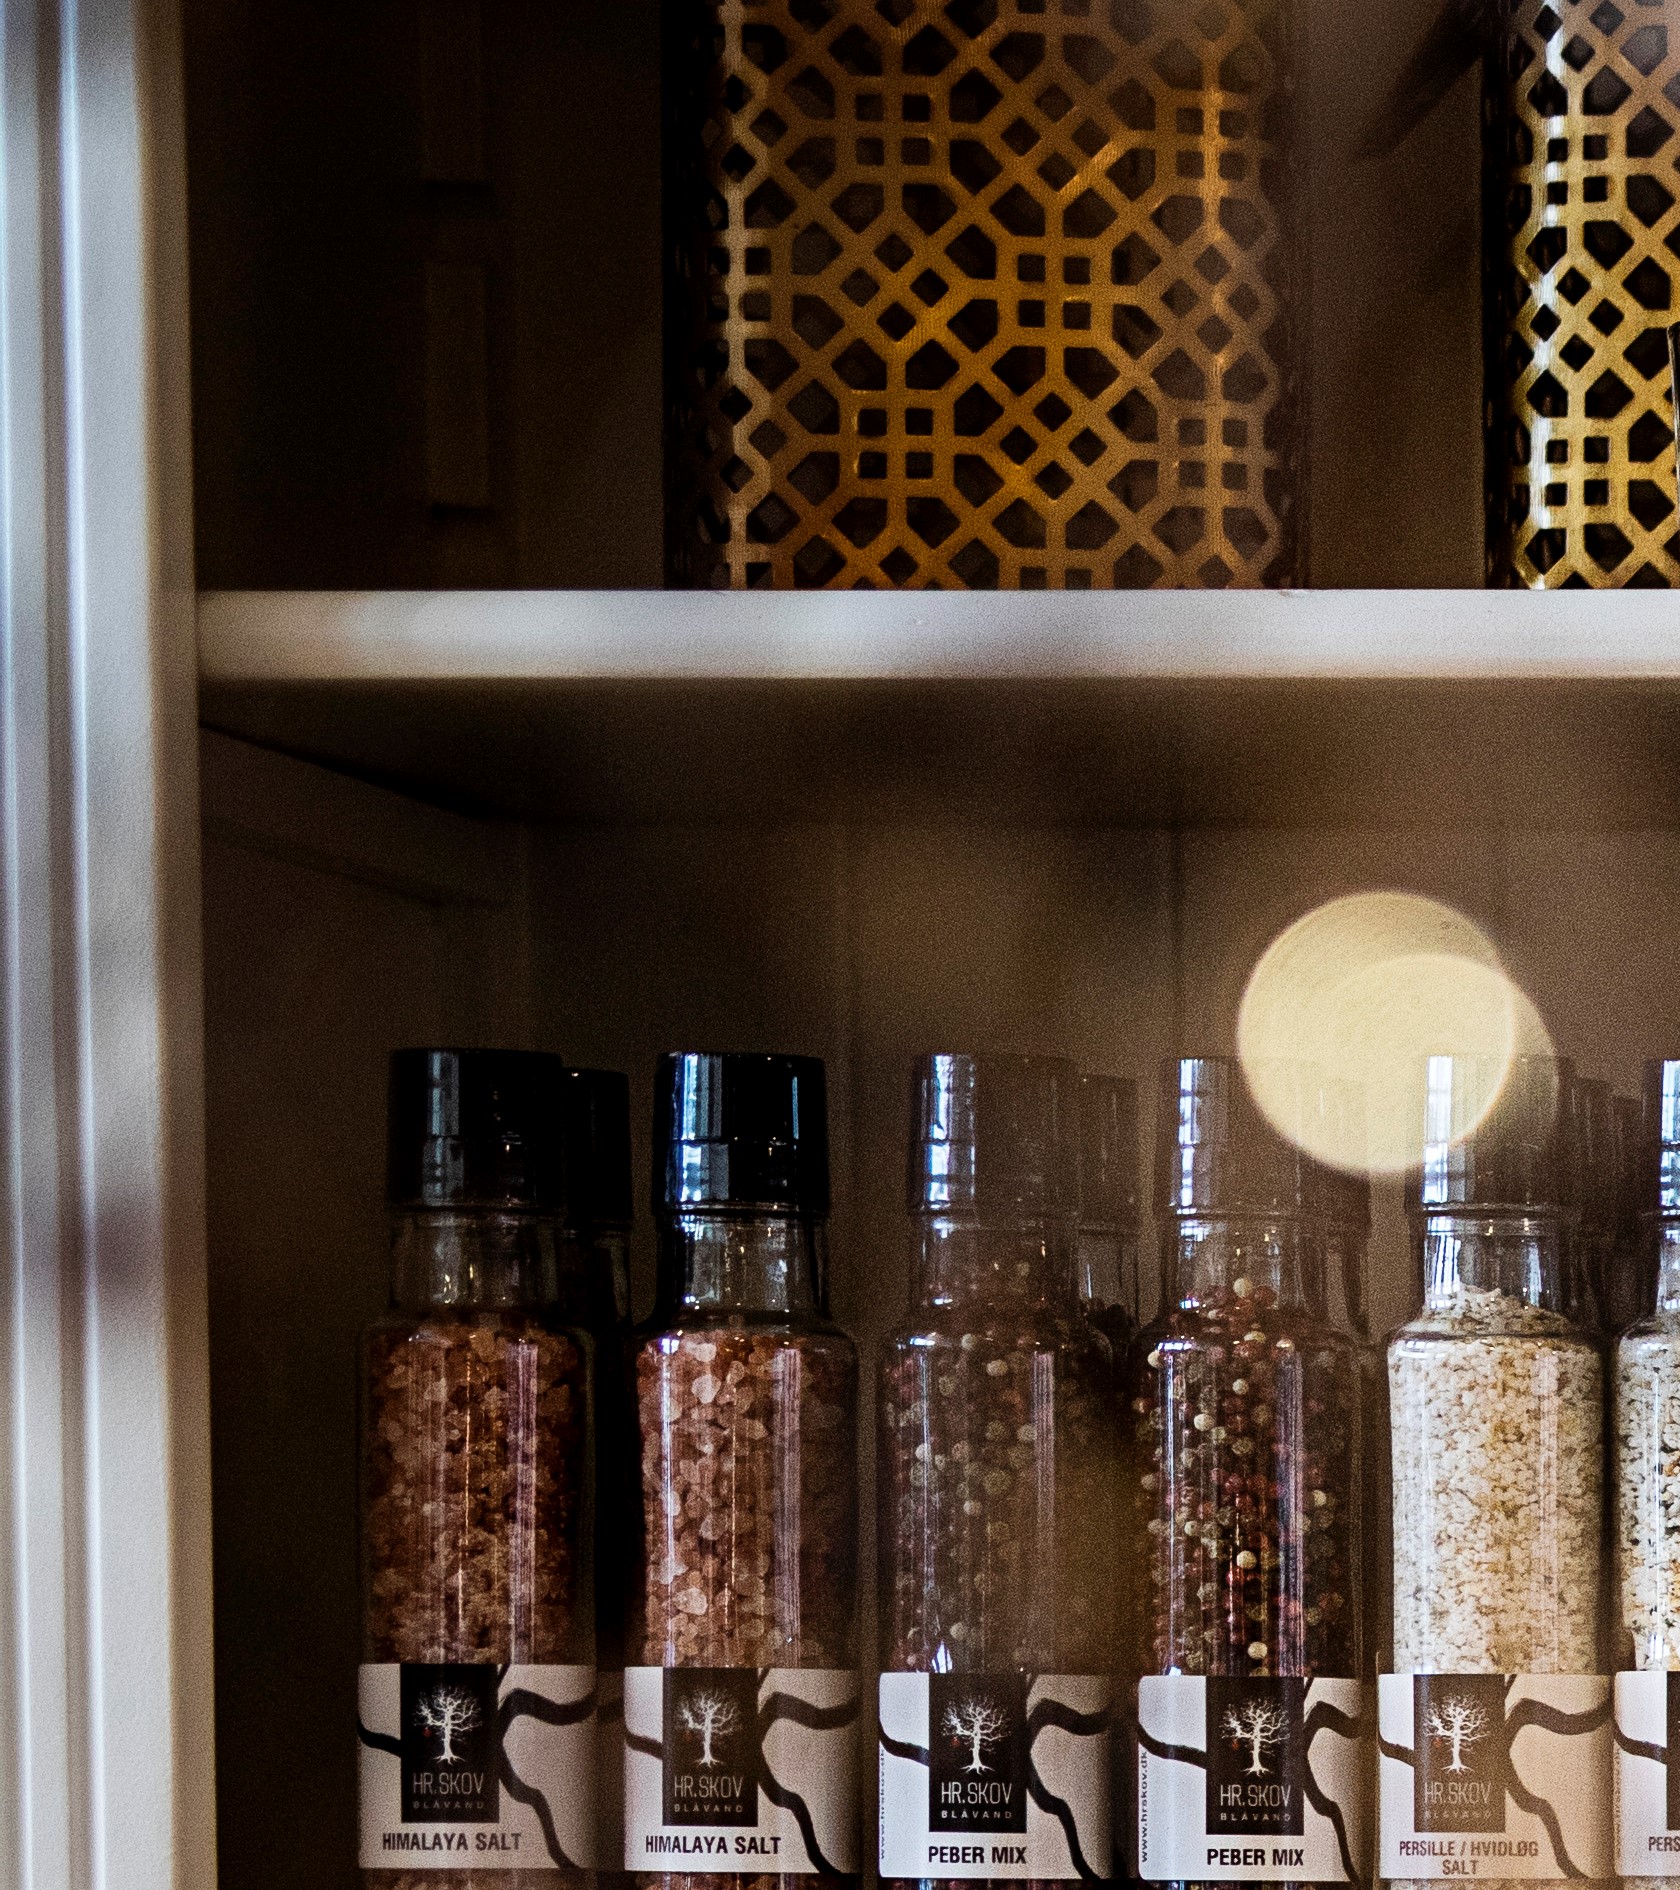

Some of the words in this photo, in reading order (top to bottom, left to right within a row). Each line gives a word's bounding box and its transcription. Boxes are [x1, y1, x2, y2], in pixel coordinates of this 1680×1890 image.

[645, 1835, 729, 1854] HIMALAYA
[734, 1835, 782, 1855] SALT
[1206, 1848, 1266, 1866] PEBER
[1272, 1848, 1304, 1867] MIX
